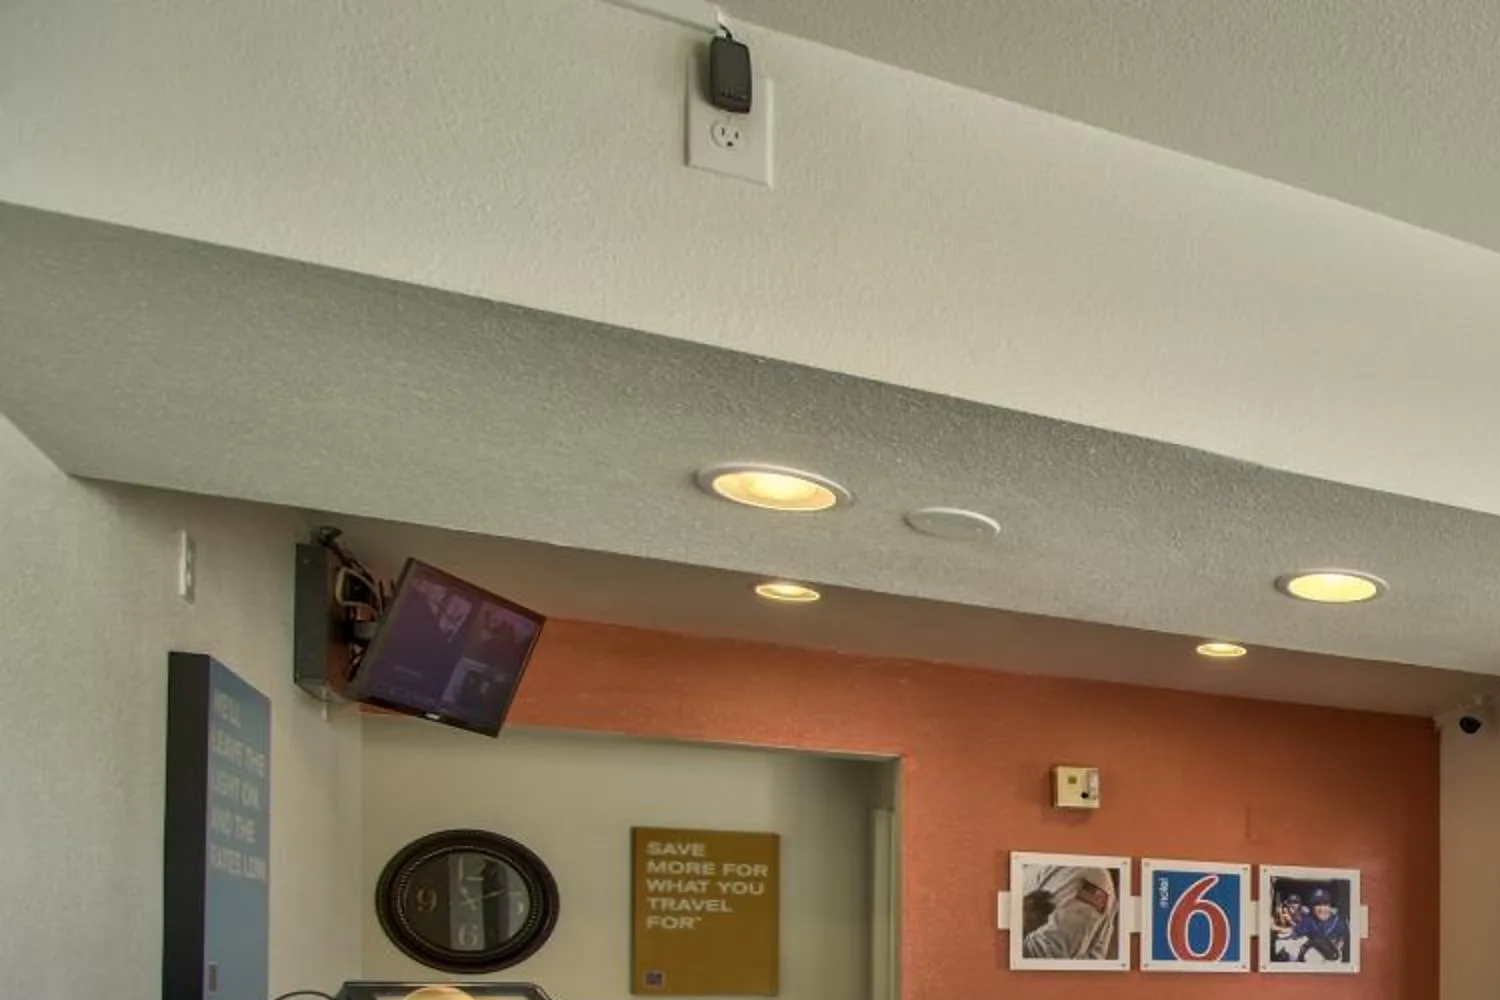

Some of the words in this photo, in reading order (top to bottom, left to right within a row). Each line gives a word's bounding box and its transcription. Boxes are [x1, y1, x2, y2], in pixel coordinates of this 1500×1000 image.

[646, 841, 707, 858] SAVE
[646, 860, 716, 877] MORE
[722, 863, 769, 877] FOR
[646, 879, 711, 894] WHAT
[717, 881, 765, 896] YOU
[647, 897, 734, 913] TRAVEL
[1167, 874, 1231, 962] 6
